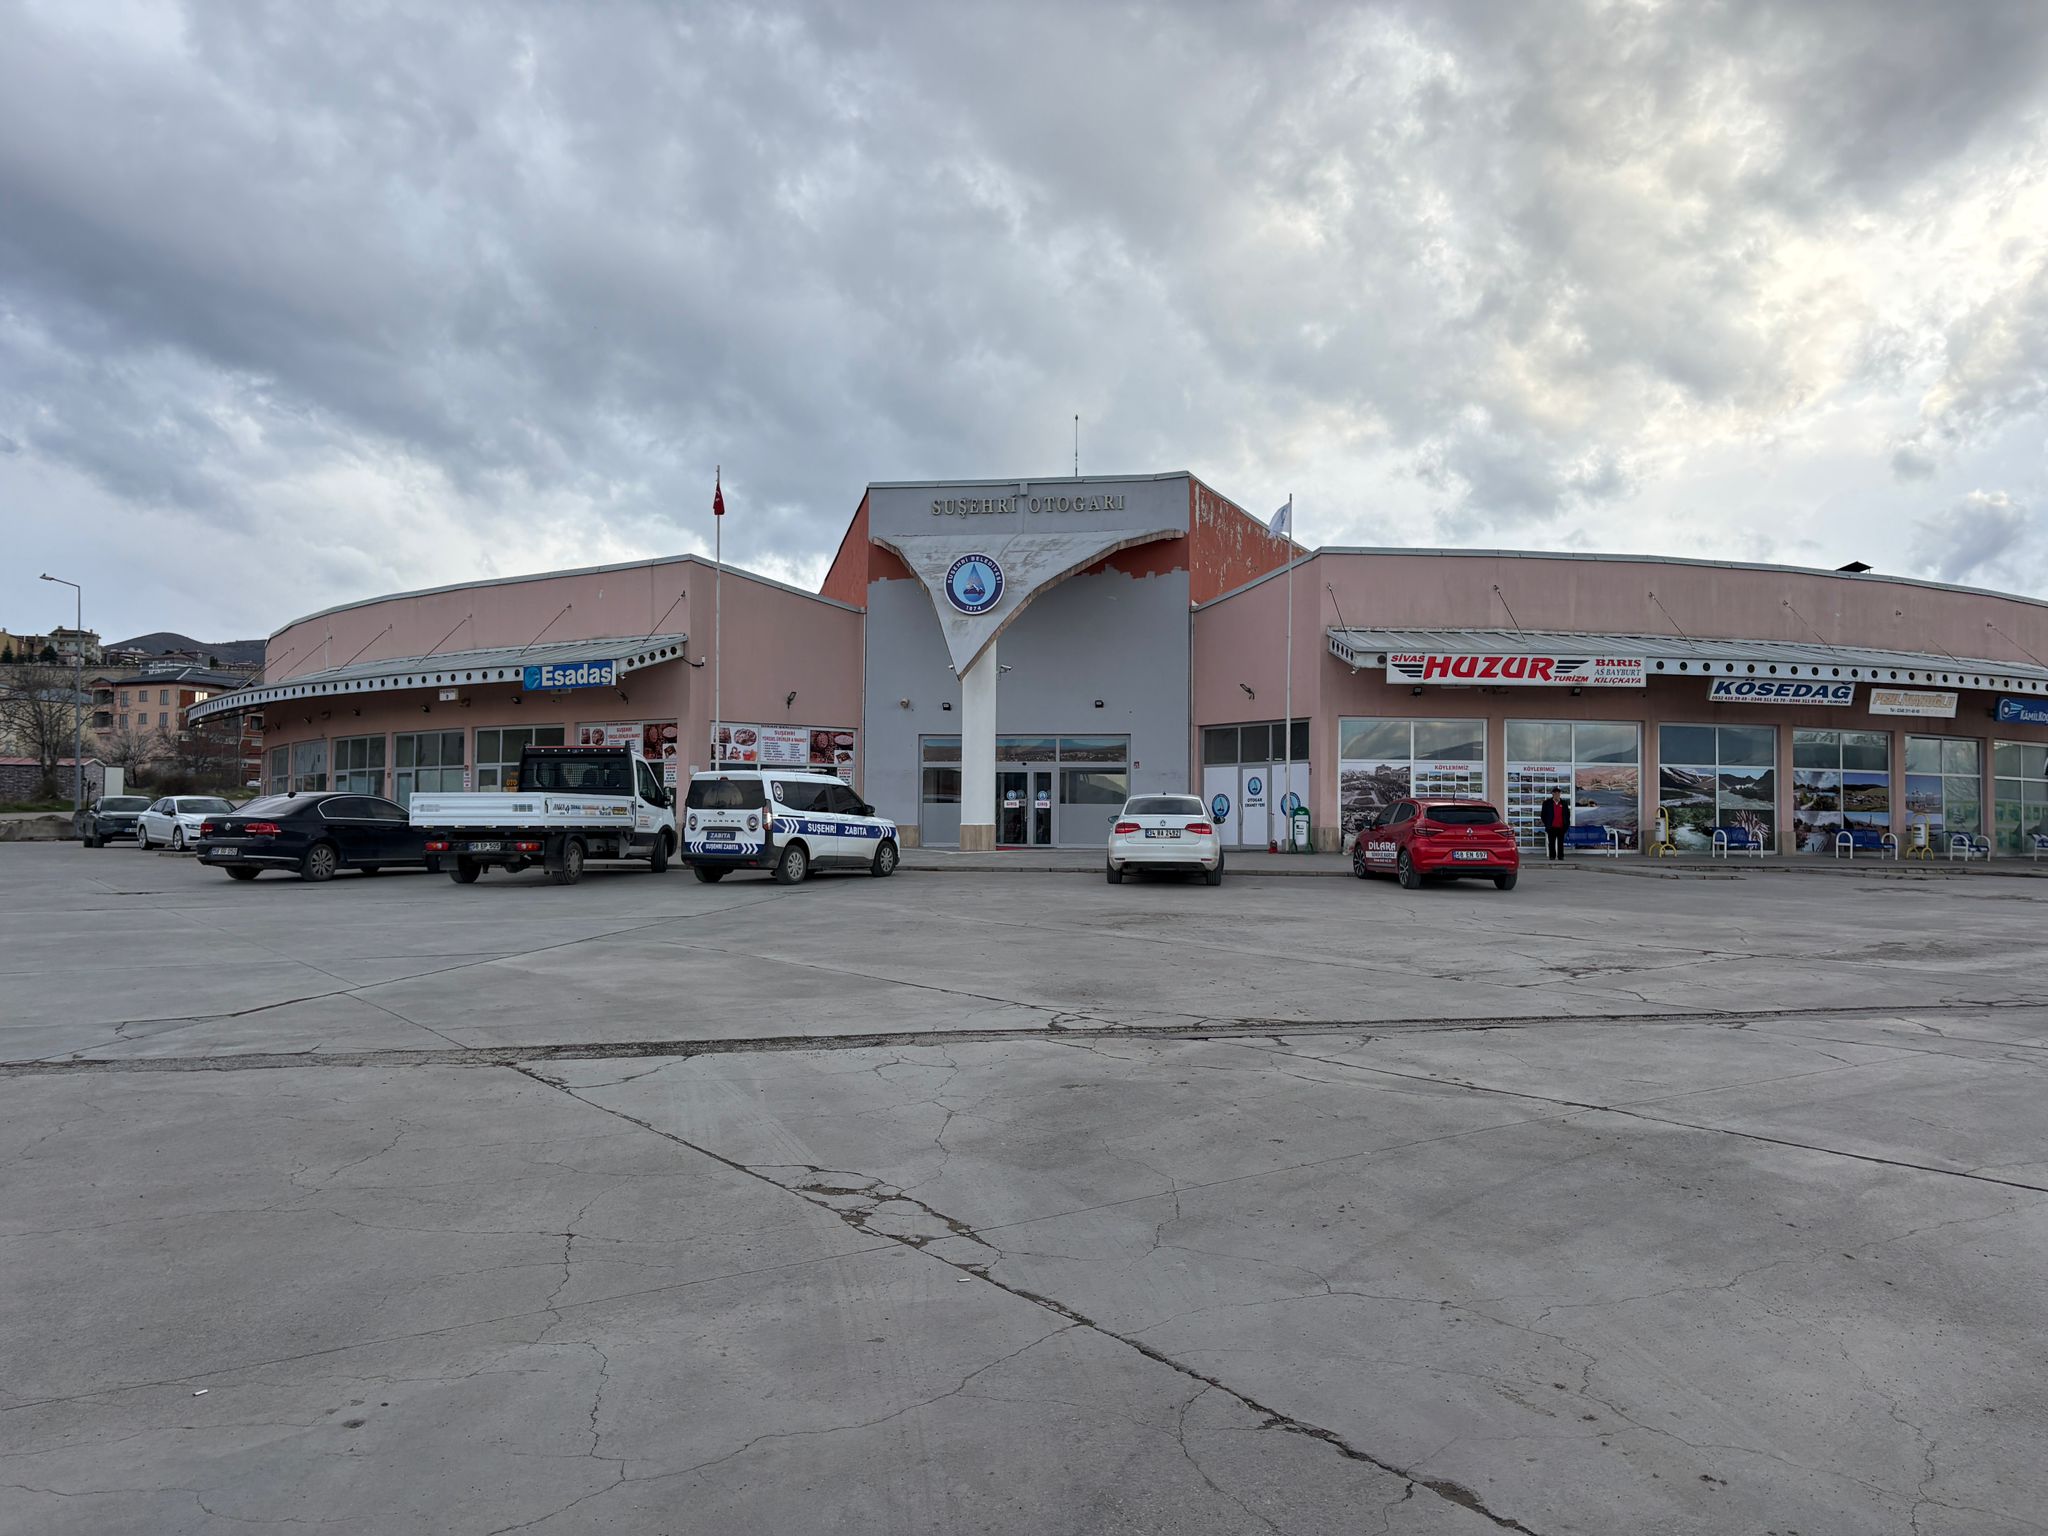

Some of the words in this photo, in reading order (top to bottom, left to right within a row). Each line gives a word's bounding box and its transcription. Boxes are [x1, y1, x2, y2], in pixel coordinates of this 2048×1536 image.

[931, 494, 1018, 519] SUŞEHRİ
[1028, 494, 1125, 513] OTOGARI
[1391, 654, 1425, 663] SİVAS
[1423, 655, 1555, 682] HUZUR
[1606, 668, 1641, 676] BAYBURT
[541, 663, 612, 687] Esadaş
[1553, 674, 1589, 683] TURİZM
[1593, 677, 1641, 686] KILIÇKAYA
[1713, 678, 1853, 700] KÖSEDAĞ
[807, 822, 837, 835] SUŞEHRİ
[844, 825, 868, 836] ZABITA
[1368, 840, 1396, 851] DİLARA
